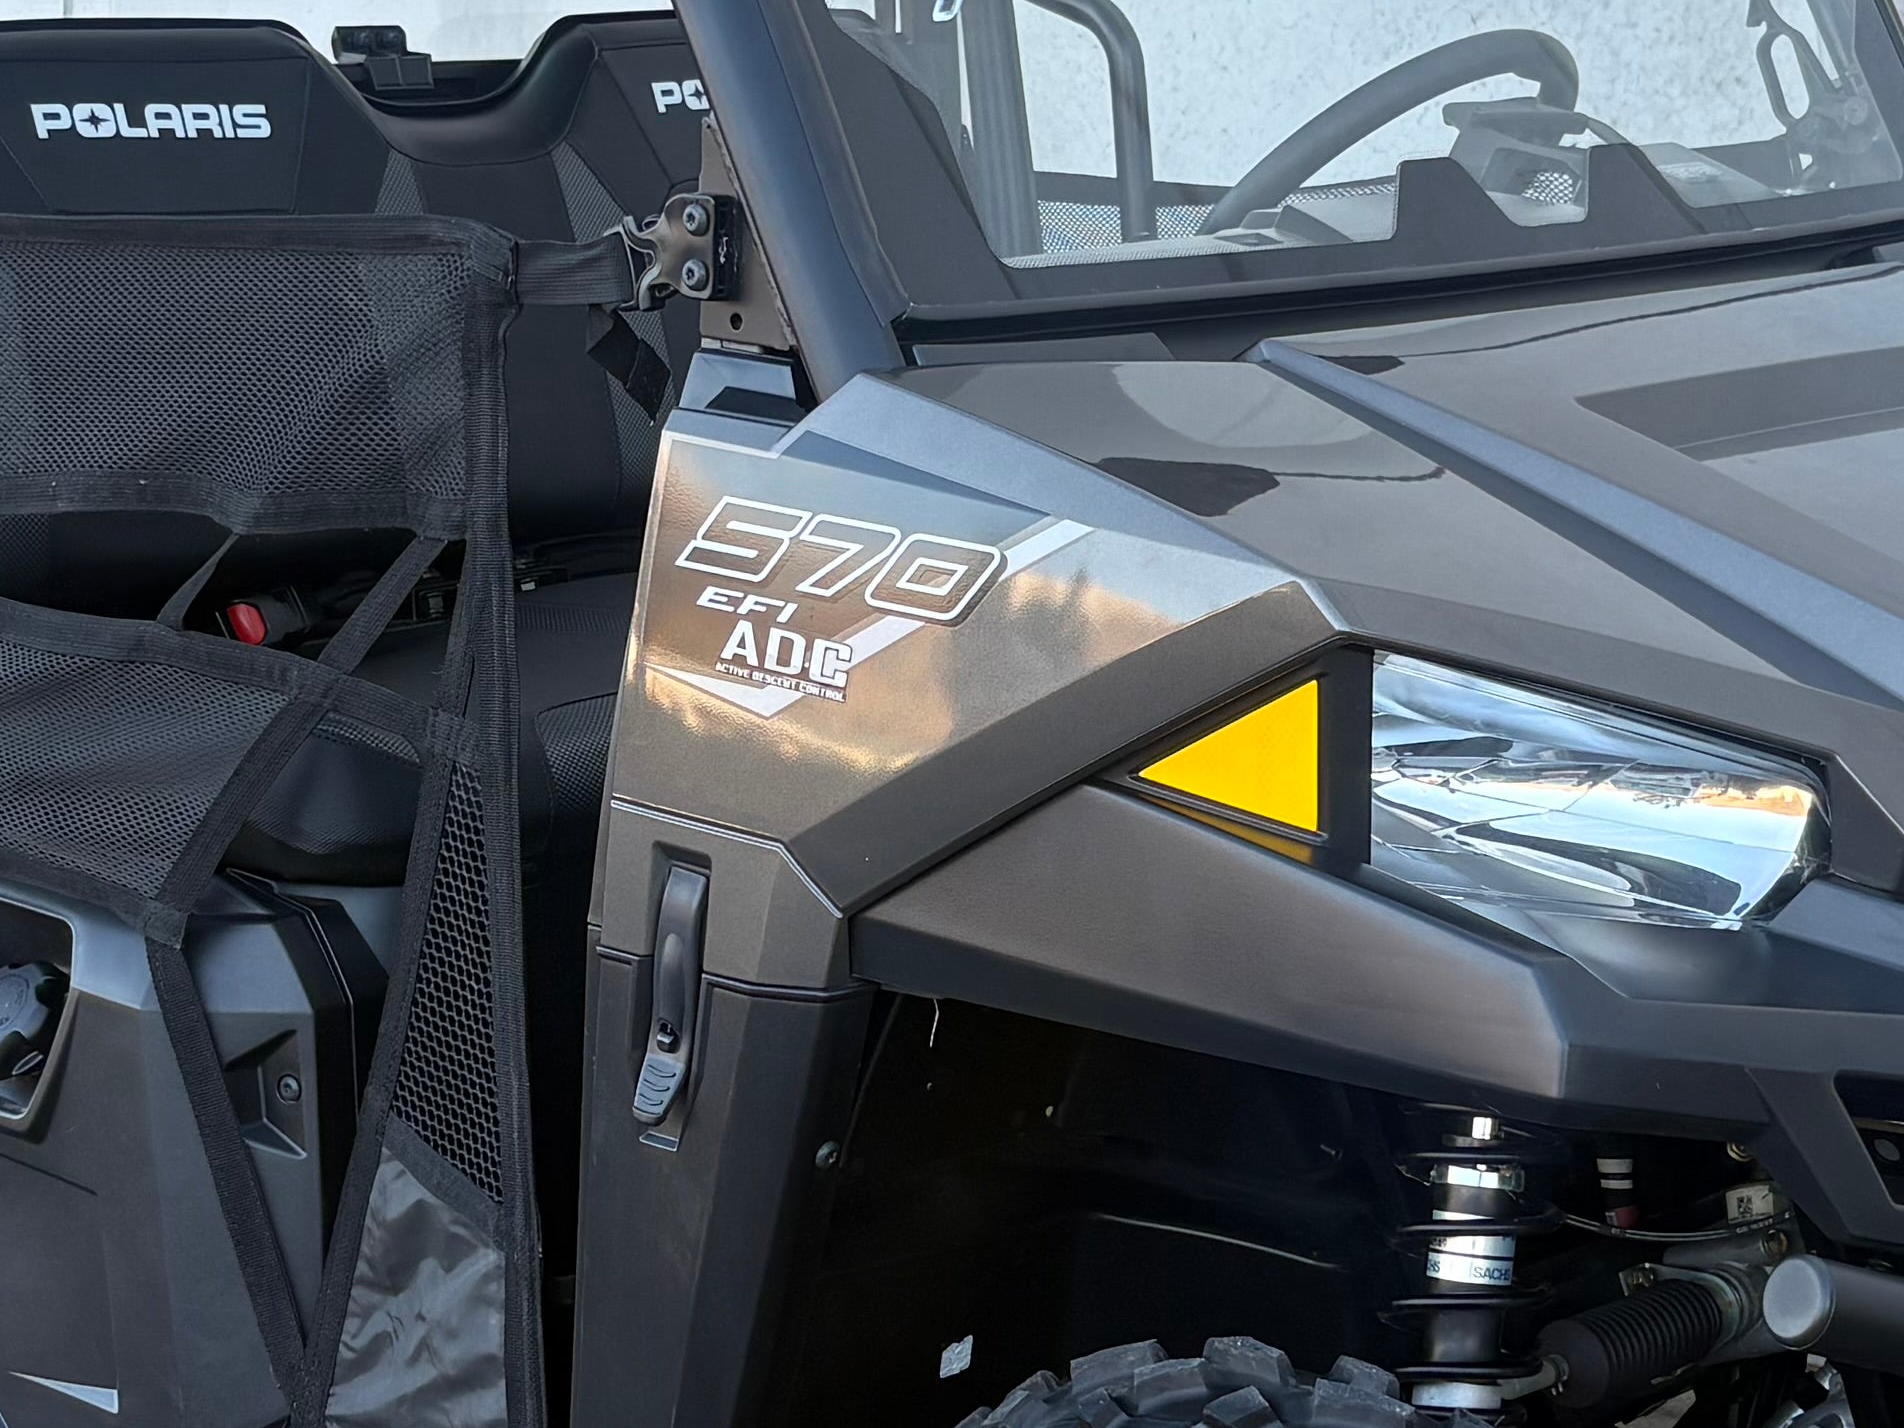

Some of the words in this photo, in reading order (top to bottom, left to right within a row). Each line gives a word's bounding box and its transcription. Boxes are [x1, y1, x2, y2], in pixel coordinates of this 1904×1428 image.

[29, 102, 272, 140] POLARIS
[674, 494, 1007, 624] 570
[696, 585, 799, 624] EFI
[719, 619, 854, 689] ADC
[715, 661, 751, 679] ACTIVE
[751, 670, 798, 691] DESCENT
[798, 679, 847, 703] CONTROL
